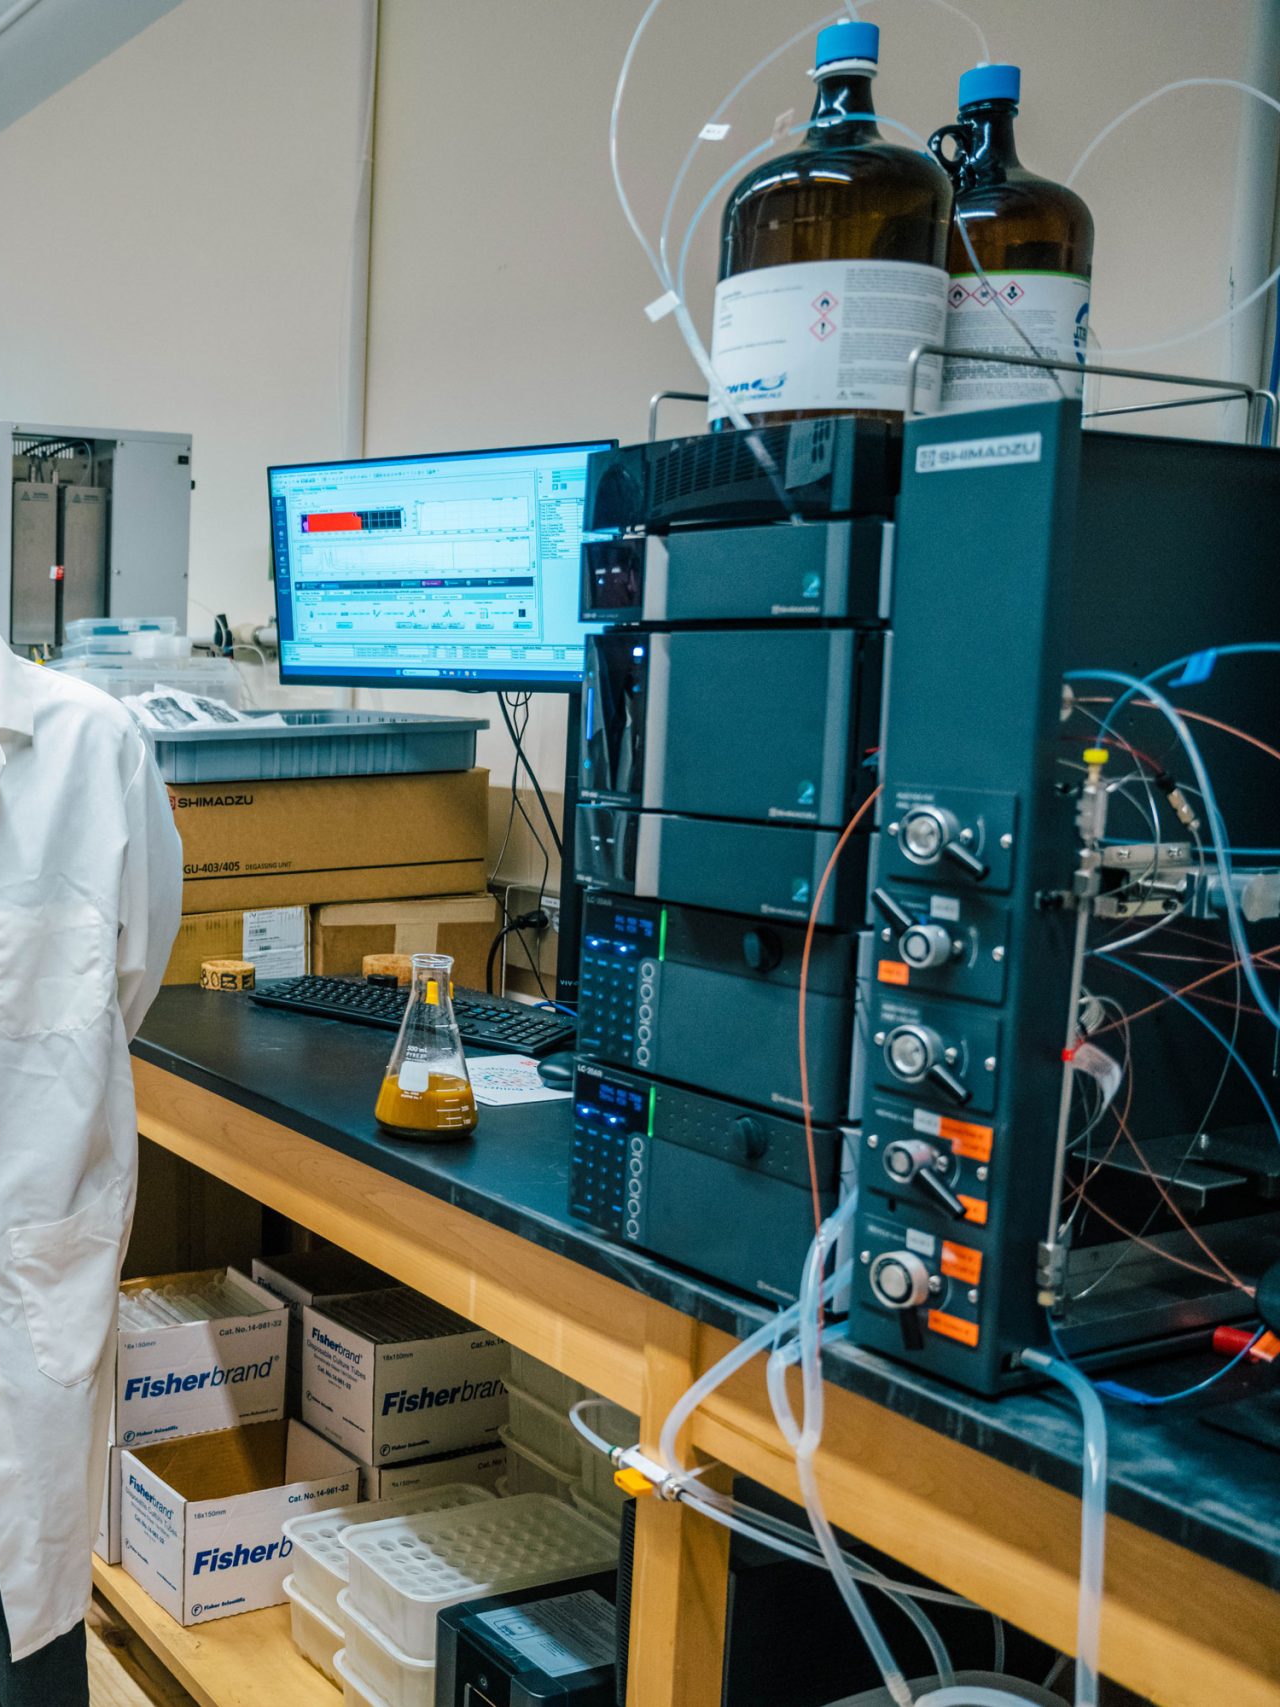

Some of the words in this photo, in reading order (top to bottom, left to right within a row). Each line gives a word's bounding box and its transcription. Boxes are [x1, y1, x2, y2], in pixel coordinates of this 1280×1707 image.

[725, 382, 750, 394] WR
[939, 441, 1037, 464] SHIMADZU
[177, 795, 254, 809] SHIMADZU
[288, 1494, 303, 1504] Cat.
[192, 1535, 294, 1576] Fisherb
